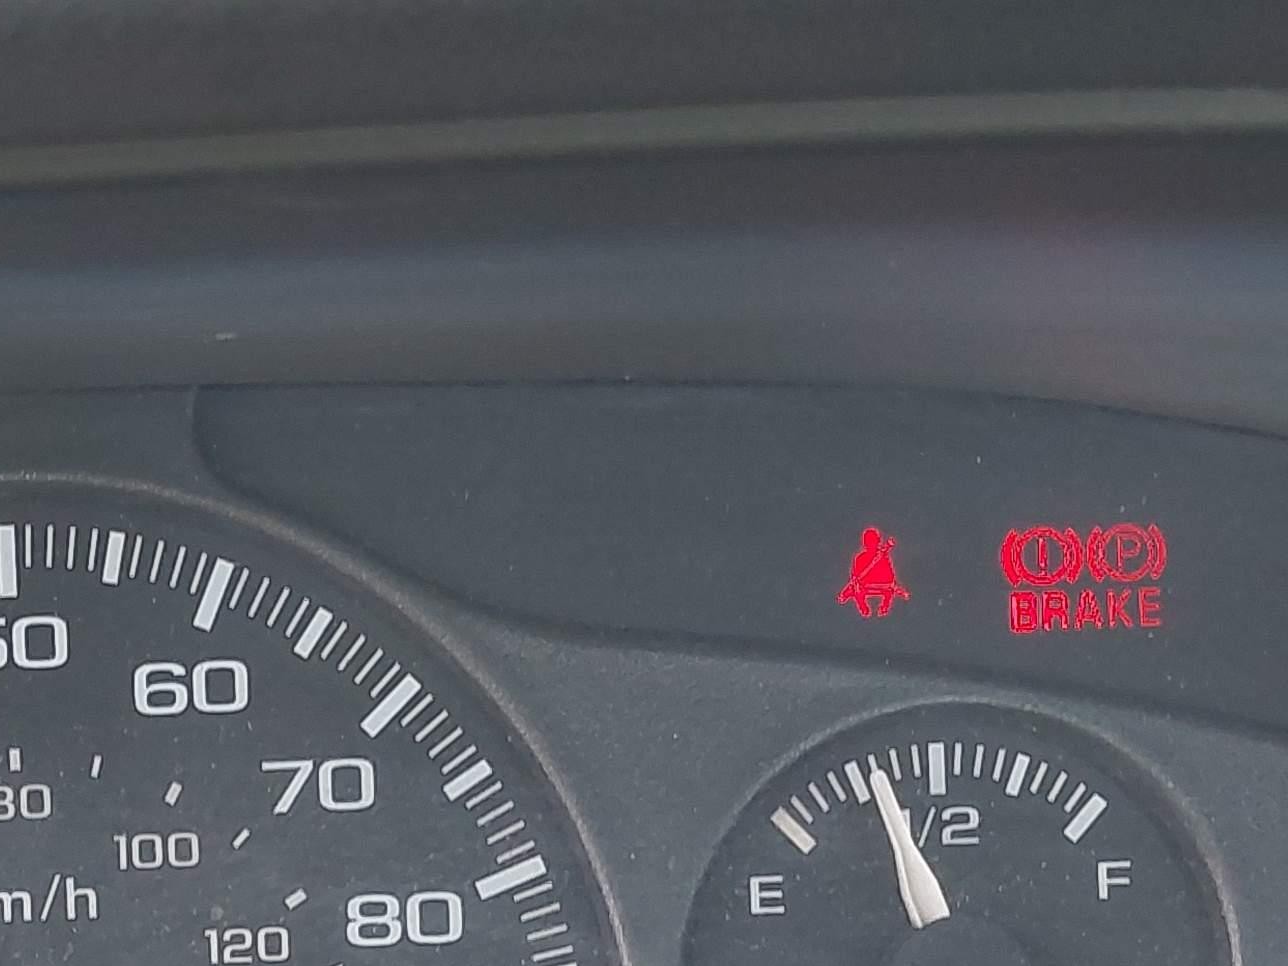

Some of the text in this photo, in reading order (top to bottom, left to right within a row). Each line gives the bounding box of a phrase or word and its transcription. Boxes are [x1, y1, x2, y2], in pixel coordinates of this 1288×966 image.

[1010, 587, 1163, 633] BRAKE
[134, 660, 249, 715] 60
[261, 758, 375, 815] 70
[113, 832, 200, 870] 100
[749, 875, 785, 915] E
[1097, 860, 1131, 900] F
[346, 891, 463, 947] 80
[204, 926, 289, 965] 120
